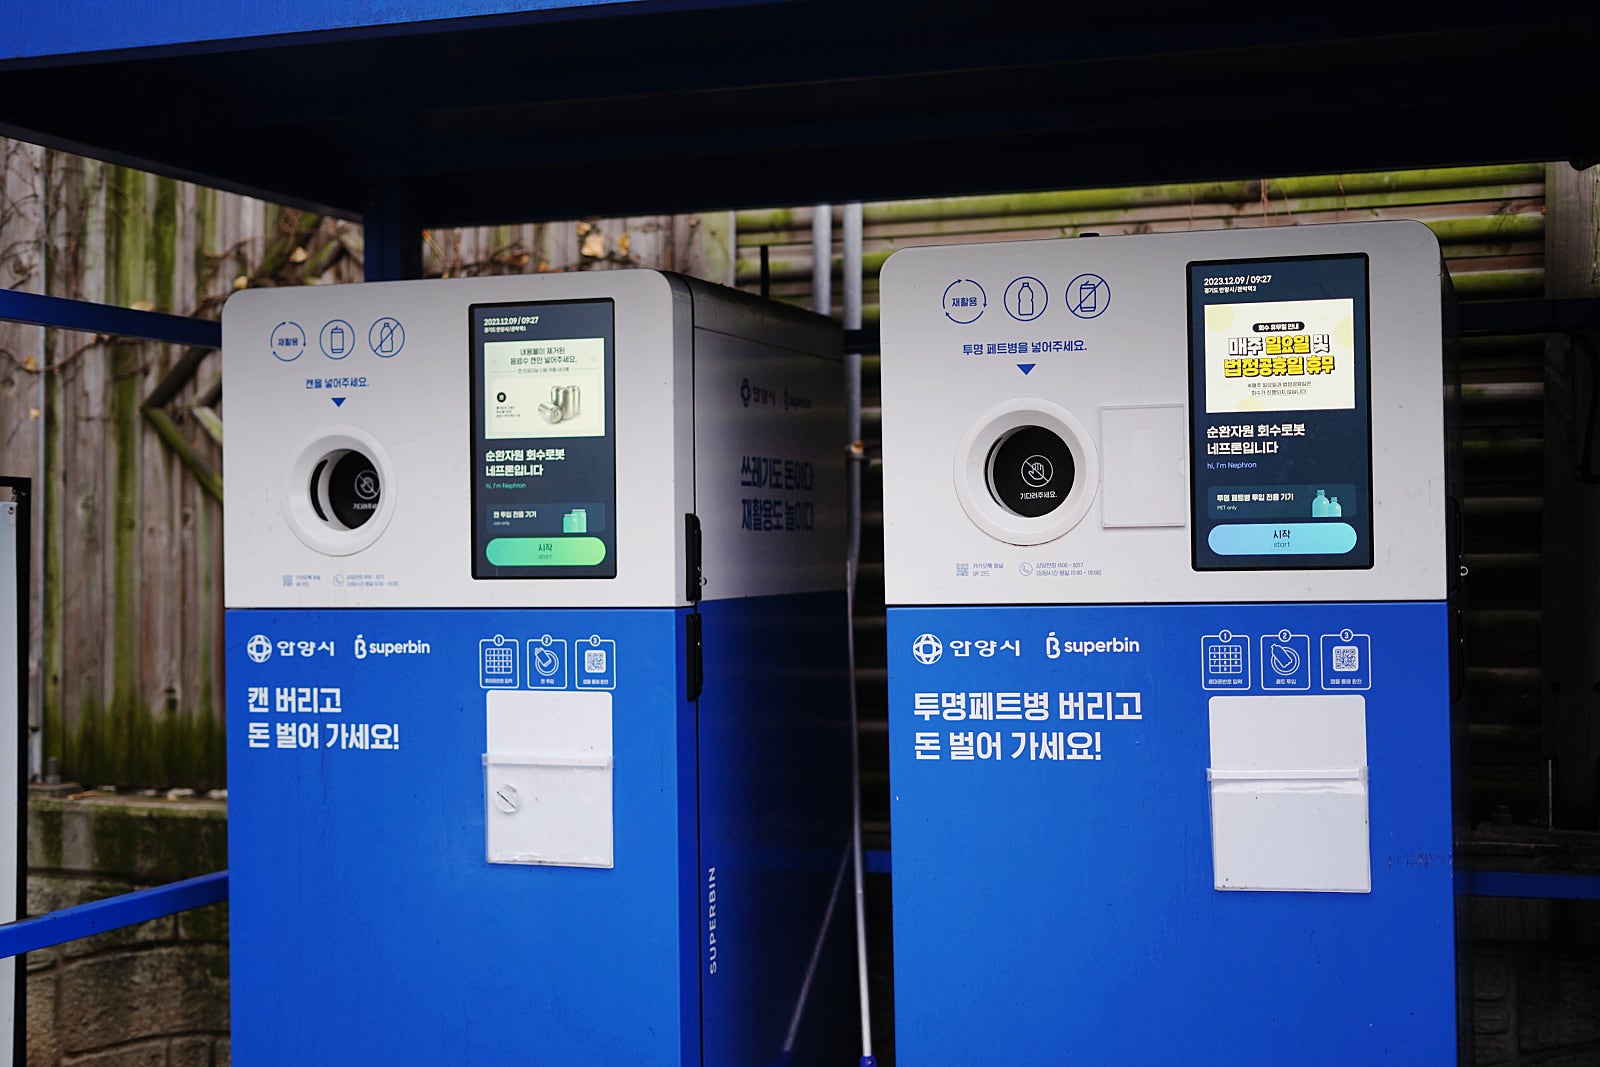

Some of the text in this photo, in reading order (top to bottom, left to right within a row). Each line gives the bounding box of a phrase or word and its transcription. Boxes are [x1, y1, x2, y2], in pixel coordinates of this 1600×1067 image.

[1204, 275, 1272, 286] 2023.12.09 / 09:27
[952, 298, 977, 307] 재활용
[278, 338, 298, 347] 재활용
[963, 340, 1087, 355] 투명 페트병을 넣어주세요.
[1228, 334, 1330, 356] 매주 일요일 및
[520, 348, 545, 356] 내용물이
[511, 357, 528, 366] 음료수
[545, 356, 577, 364] 넣어주세요.
[1224, 356, 1335, 378] 법정공휴일 휴무
[306, 377, 369, 389] 캔을 넣어주세요.
[1207, 424, 1305, 438] 순환자원 회수로봇
[485, 448, 565, 462] 순환자원 회수로봇
[1207, 442, 1278, 455] 네프론입니다
[485, 464, 544, 477] 네프론입니다
[1228, 462, 1257, 470] Nephron
[741, 456, 814, 491] 쓰레기도 돈이다
[502, 482, 526, 490] Nephron
[1020, 491, 1058, 500] 기다려주세요.
[1280, 493, 1294, 501] 기기
[742, 498, 783, 531] 재활용도
[1273, 530, 1291, 539] 시작
[538, 544, 552, 552] 시작
[1283, 632, 1287, 640] 2
[277, 641, 334, 657] 안양시
[369, 640, 431, 657] superbin
[950, 640, 1020, 657] 안양시
[1064, 637, 1140, 656] superbin
[248, 687, 342, 714] 캔 버리고
[914, 692, 1142, 721] 투명페트병 버리고
[248, 722, 400, 750] 돈 벌어 가세요!
[915, 732, 1101, 760] 돈 벌어 가세요!
[708, 867, 717, 975] SUPERBIN
